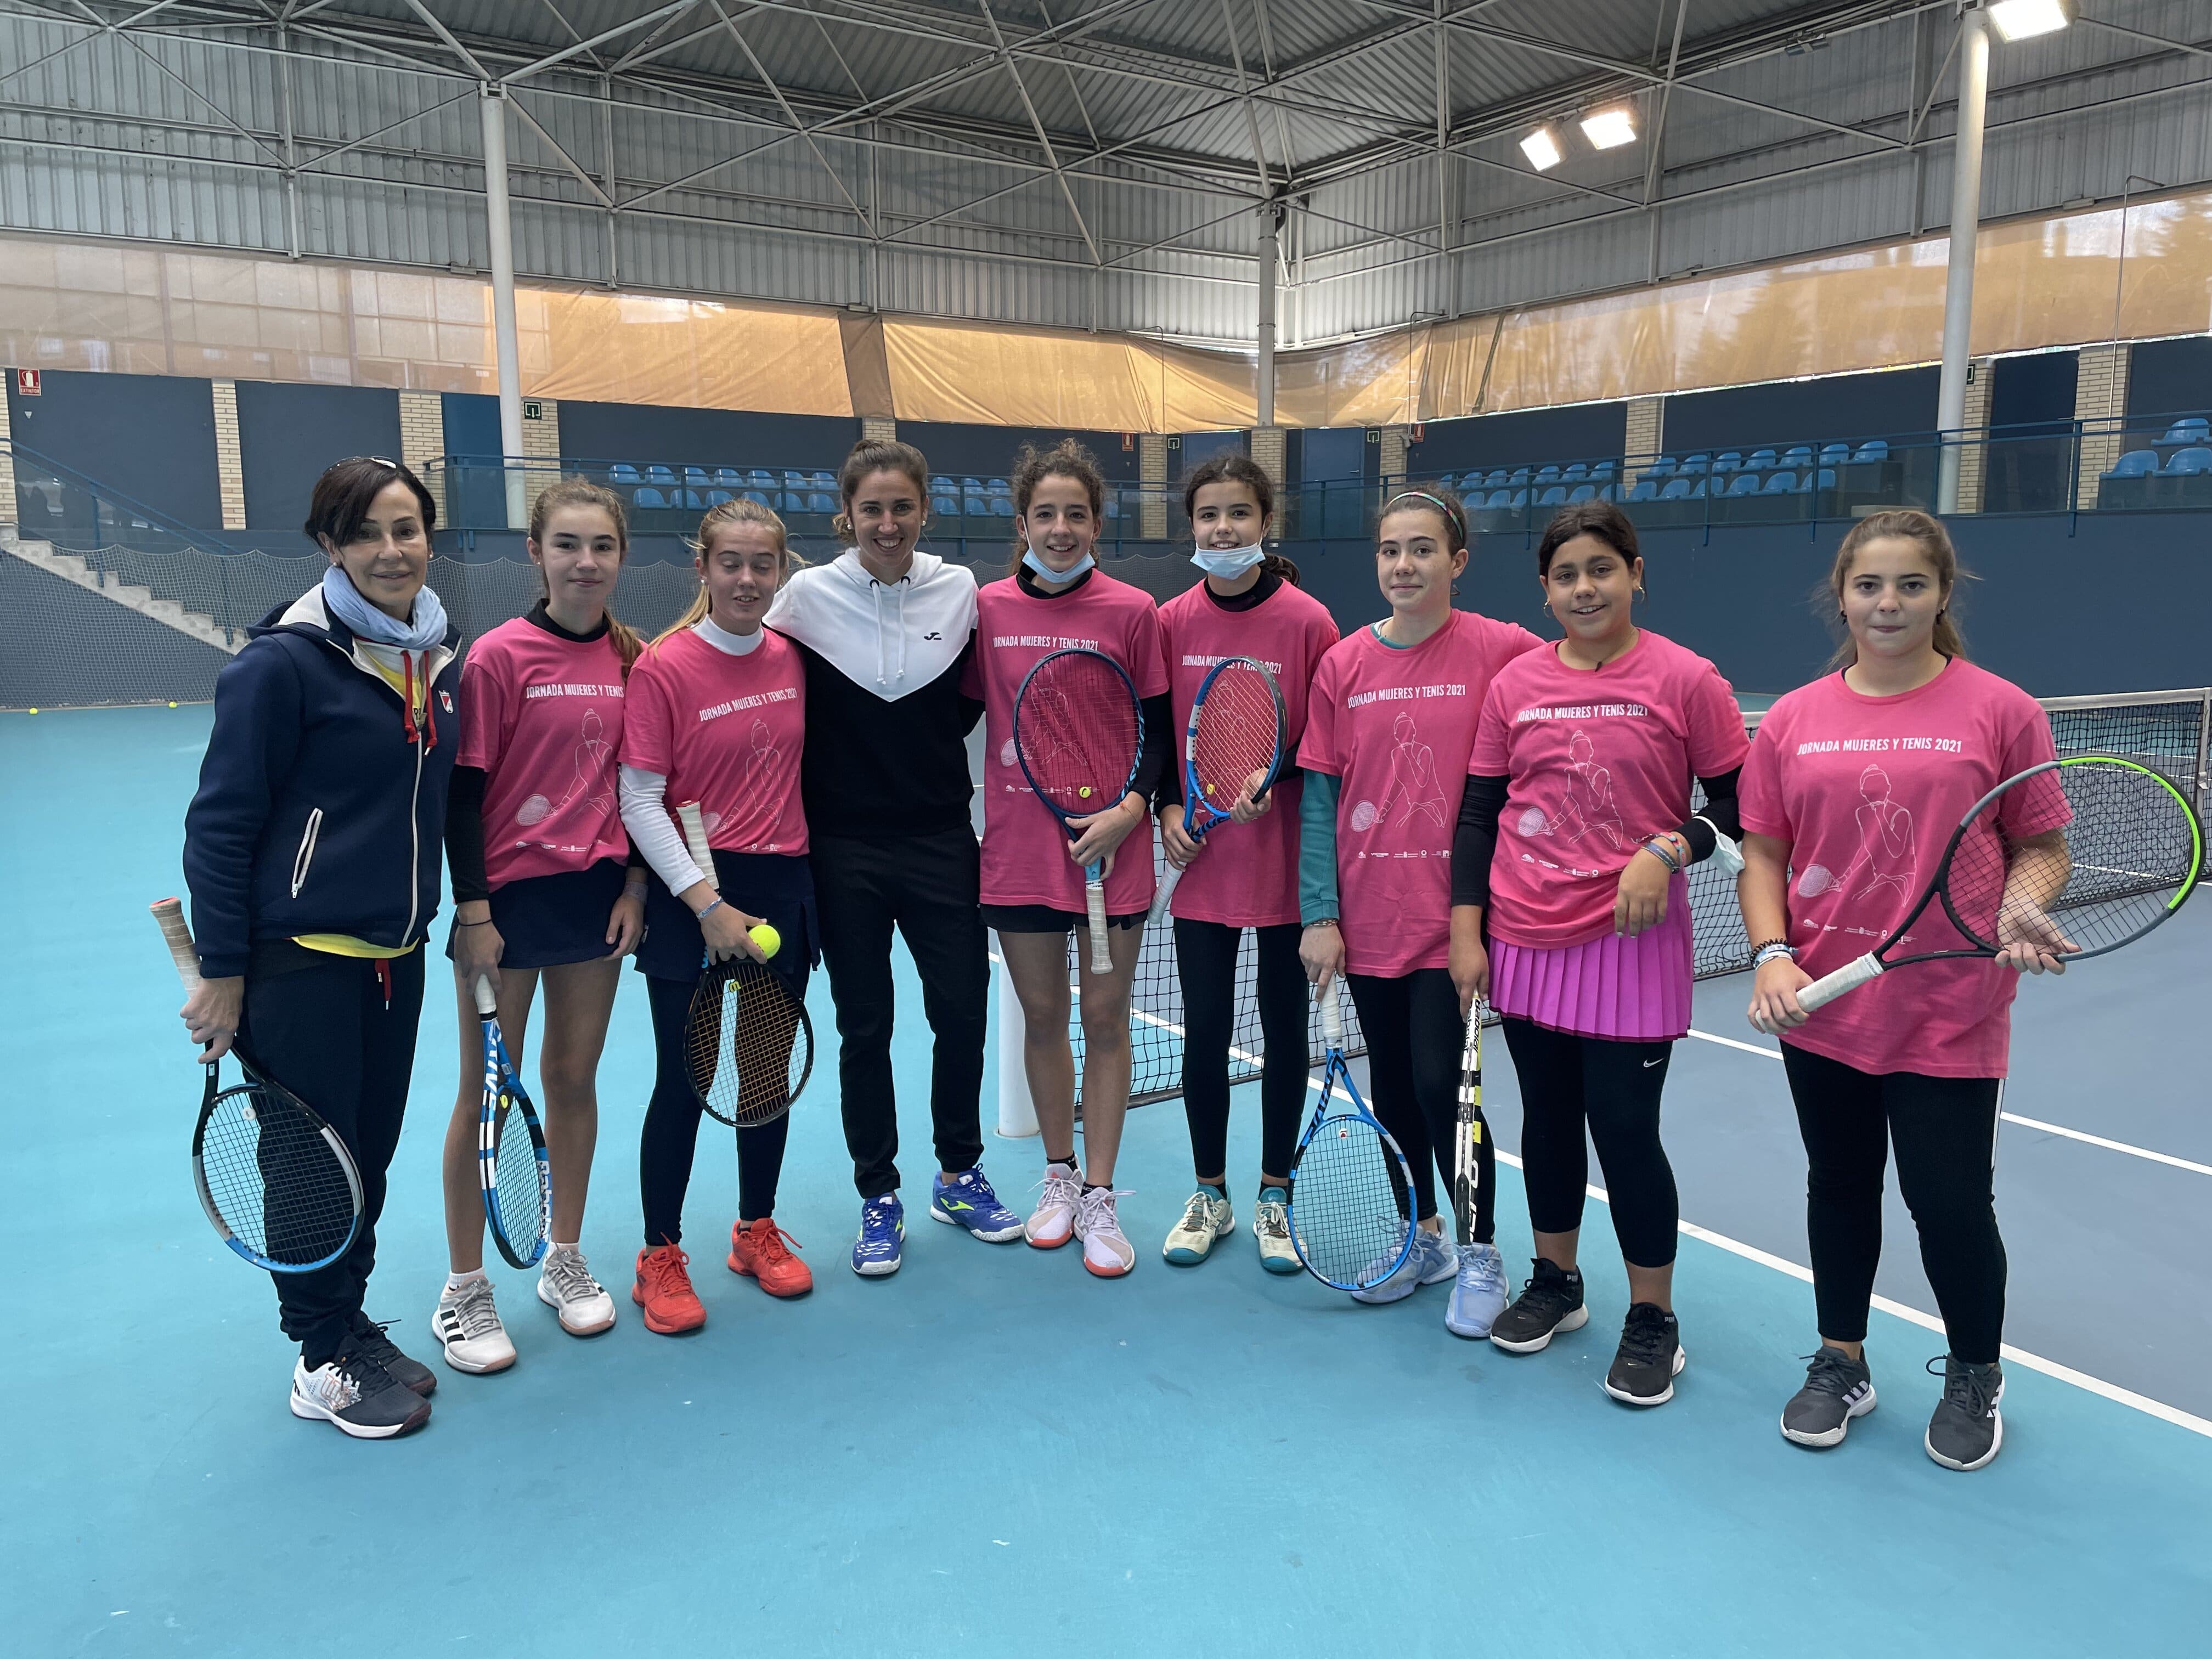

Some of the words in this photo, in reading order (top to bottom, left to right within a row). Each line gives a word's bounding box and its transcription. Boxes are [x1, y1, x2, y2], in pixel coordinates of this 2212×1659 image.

[1020, 636, 1051, 647] MUJERES
[1052, 636, 1058, 647] Y
[1059, 637, 1079, 649] TENIS
[1081, 639, 1099, 651] 2021
[1182, 654, 1205, 666] JORNADA
[1265, 661, 1282, 674] 2021
[526, 684, 563, 699] JORNADA
[564, 684, 597, 696] MUJERES
[599, 685, 603, 696] Y
[603, 685, 624, 698] TENIS
[1347, 691, 1377, 709] JORNADA
[1378, 686, 1413, 701] MUJERES
[1414, 687, 1421, 698] Y
[1421, 684, 1444, 698] TENIS
[1446, 684, 1466, 696] 2021
[699, 702, 733, 722] JORNADA
[731, 695, 763, 712] MUJERES
[761, 693, 768, 704] Y
[766, 689, 787, 703] TENIS
[785, 687, 798, 699] 2021
[1516, 707, 1553, 723] JORNADA
[1554, 706, 1592, 719] MUJERES
[1593, 705, 1599, 718] Y
[1600, 704, 1626, 716] TENIS
[1627, 704, 1648, 716] 2021
[1797, 740, 1839, 755] JORNADA
[1843, 738, 1890, 752] MUJERES
[1892, 738, 1899, 750] Y
[1901, 737, 1933, 750] TENIS
[1934, 738, 1962, 753] 2021
